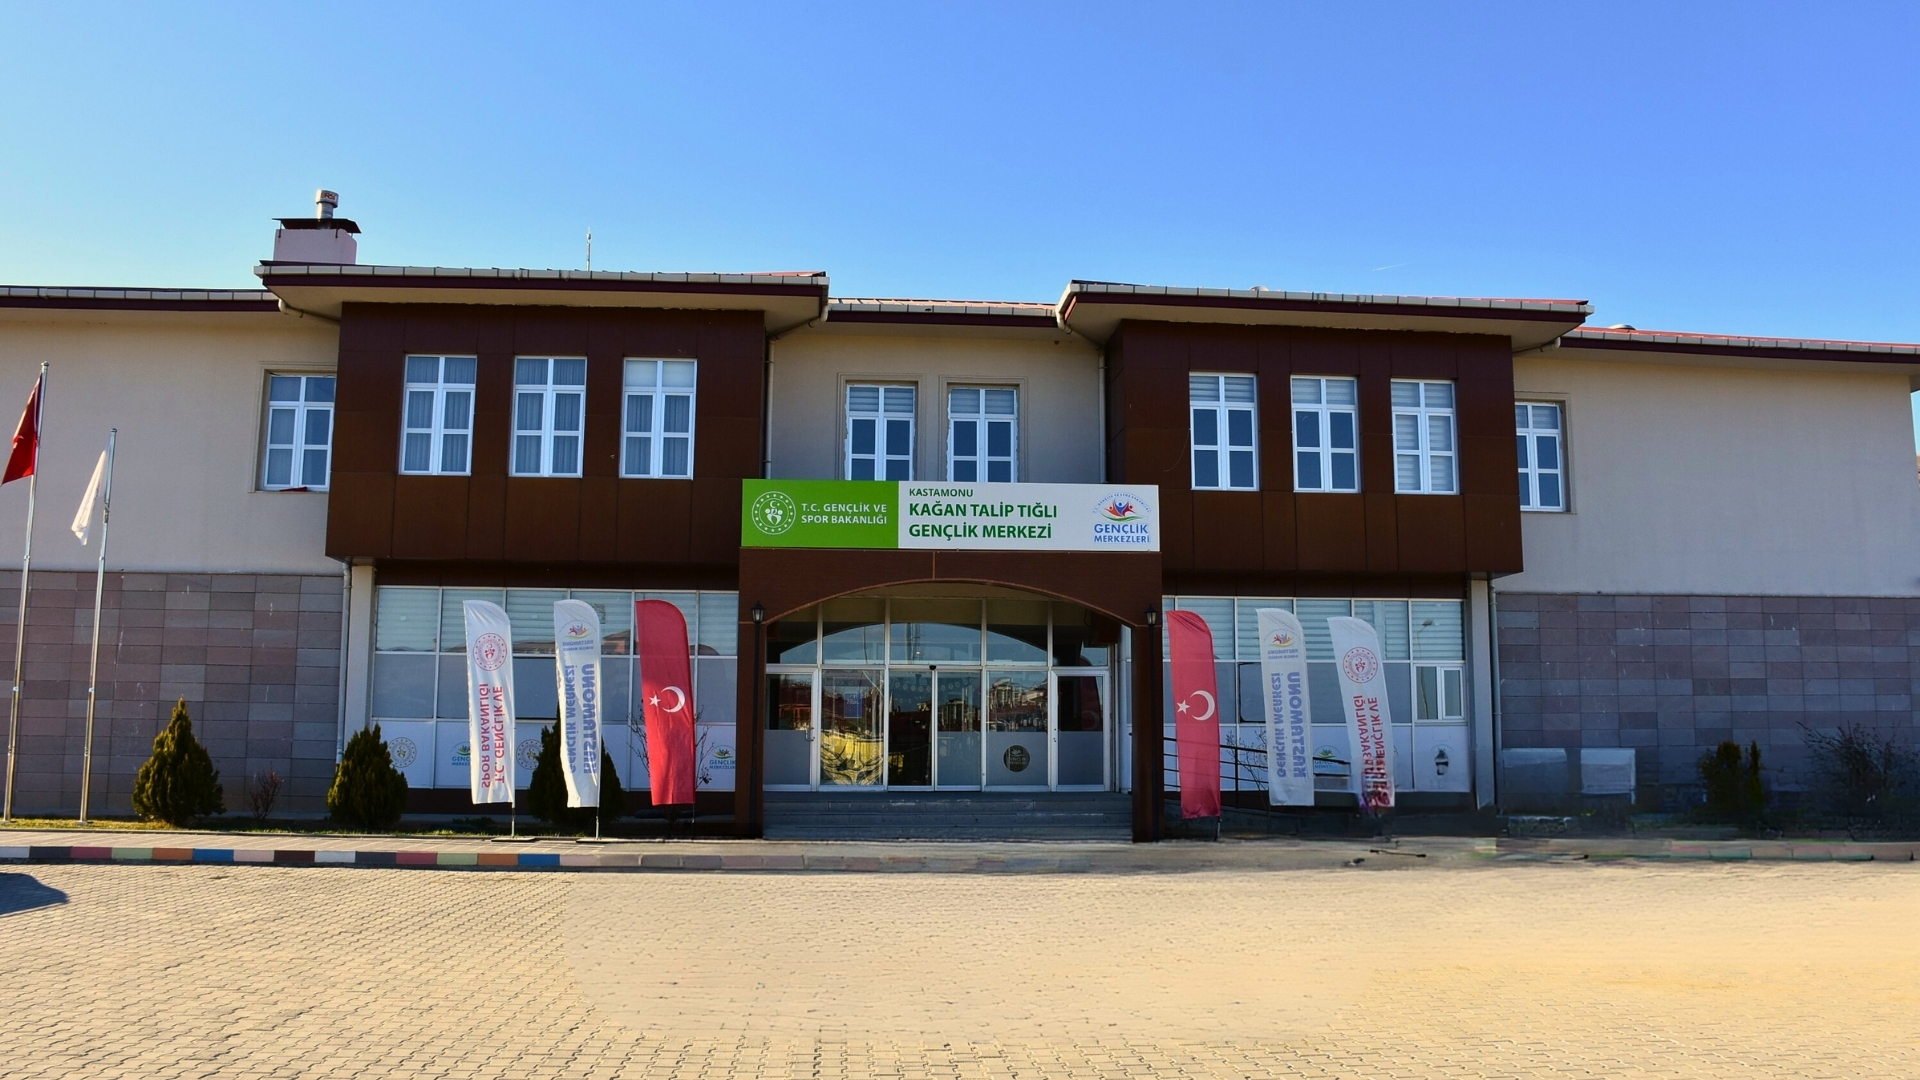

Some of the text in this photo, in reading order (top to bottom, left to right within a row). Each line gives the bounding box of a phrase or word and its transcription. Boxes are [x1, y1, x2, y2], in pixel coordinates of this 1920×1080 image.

[909, 488, 974, 498] KASTAMONU
[801, 502, 887, 514] T.C. GENÇLİK VE
[909, 500, 1057, 518] KAĞAN TALİP TIĞLI
[801, 514, 887, 525] SPOR BAKANLIĞI
[908, 521, 1052, 542] GENÇLİK MERKEZİ
[1094, 523, 1148, 535] GENÇLİK
[1094, 535, 1150, 543] MERKEZLERİ
